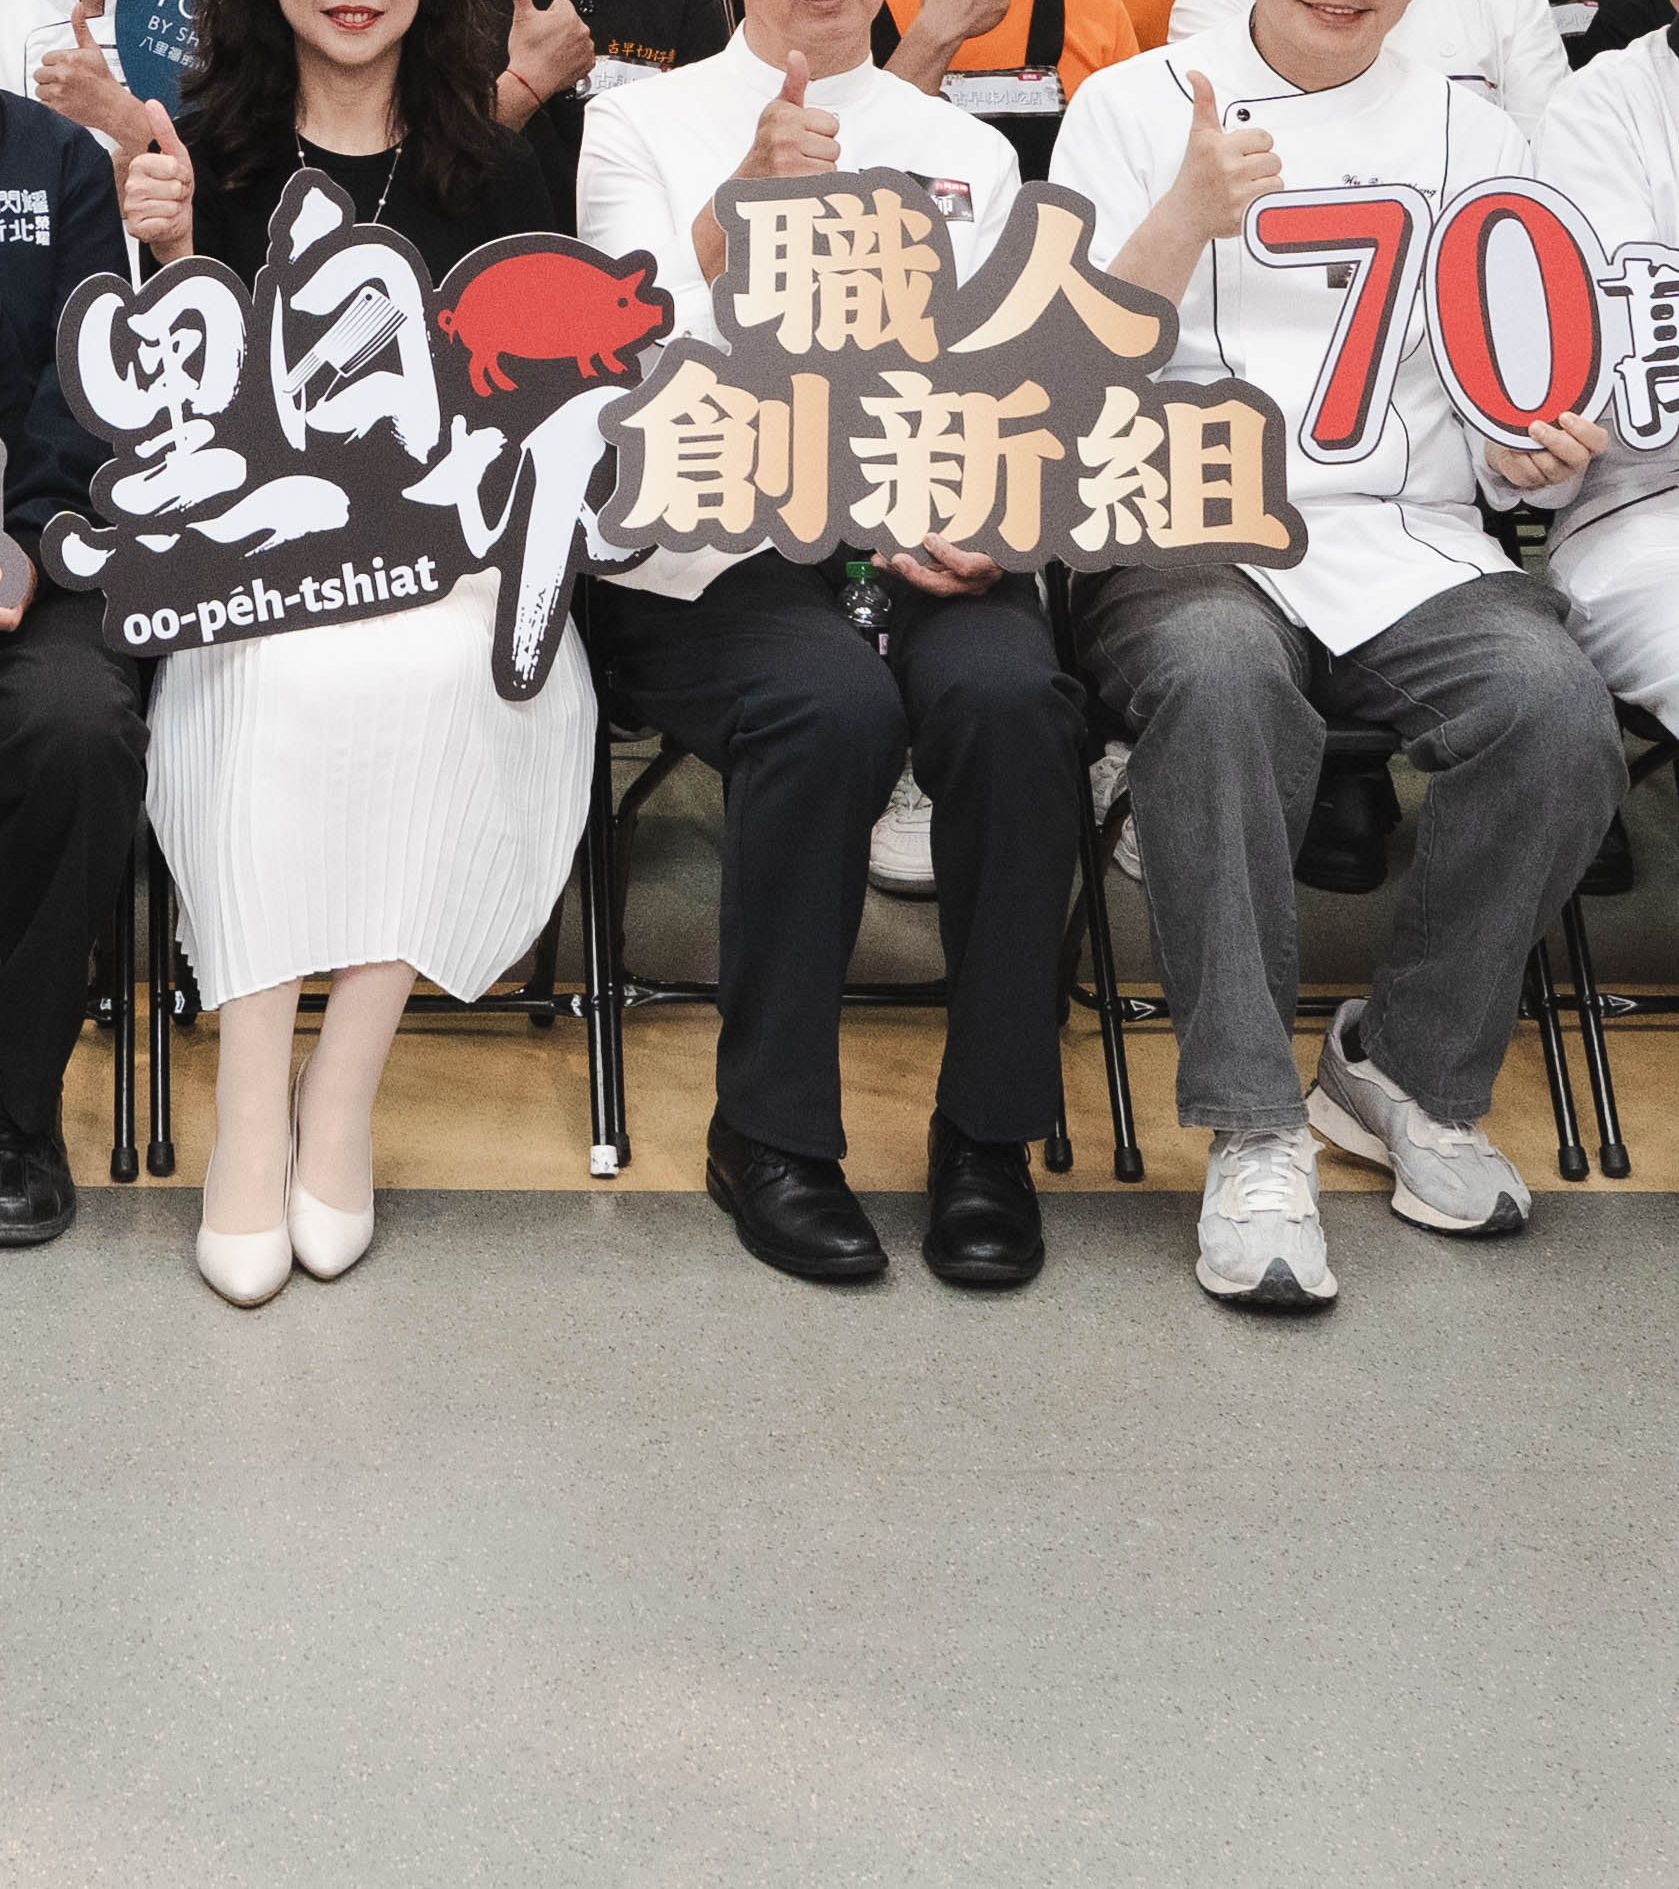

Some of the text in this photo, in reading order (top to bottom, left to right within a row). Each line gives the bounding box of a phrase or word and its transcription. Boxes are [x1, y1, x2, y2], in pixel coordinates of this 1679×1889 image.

[732, 185, 1161, 362] 職人
[620, 359, 1292, 553] 創新組
